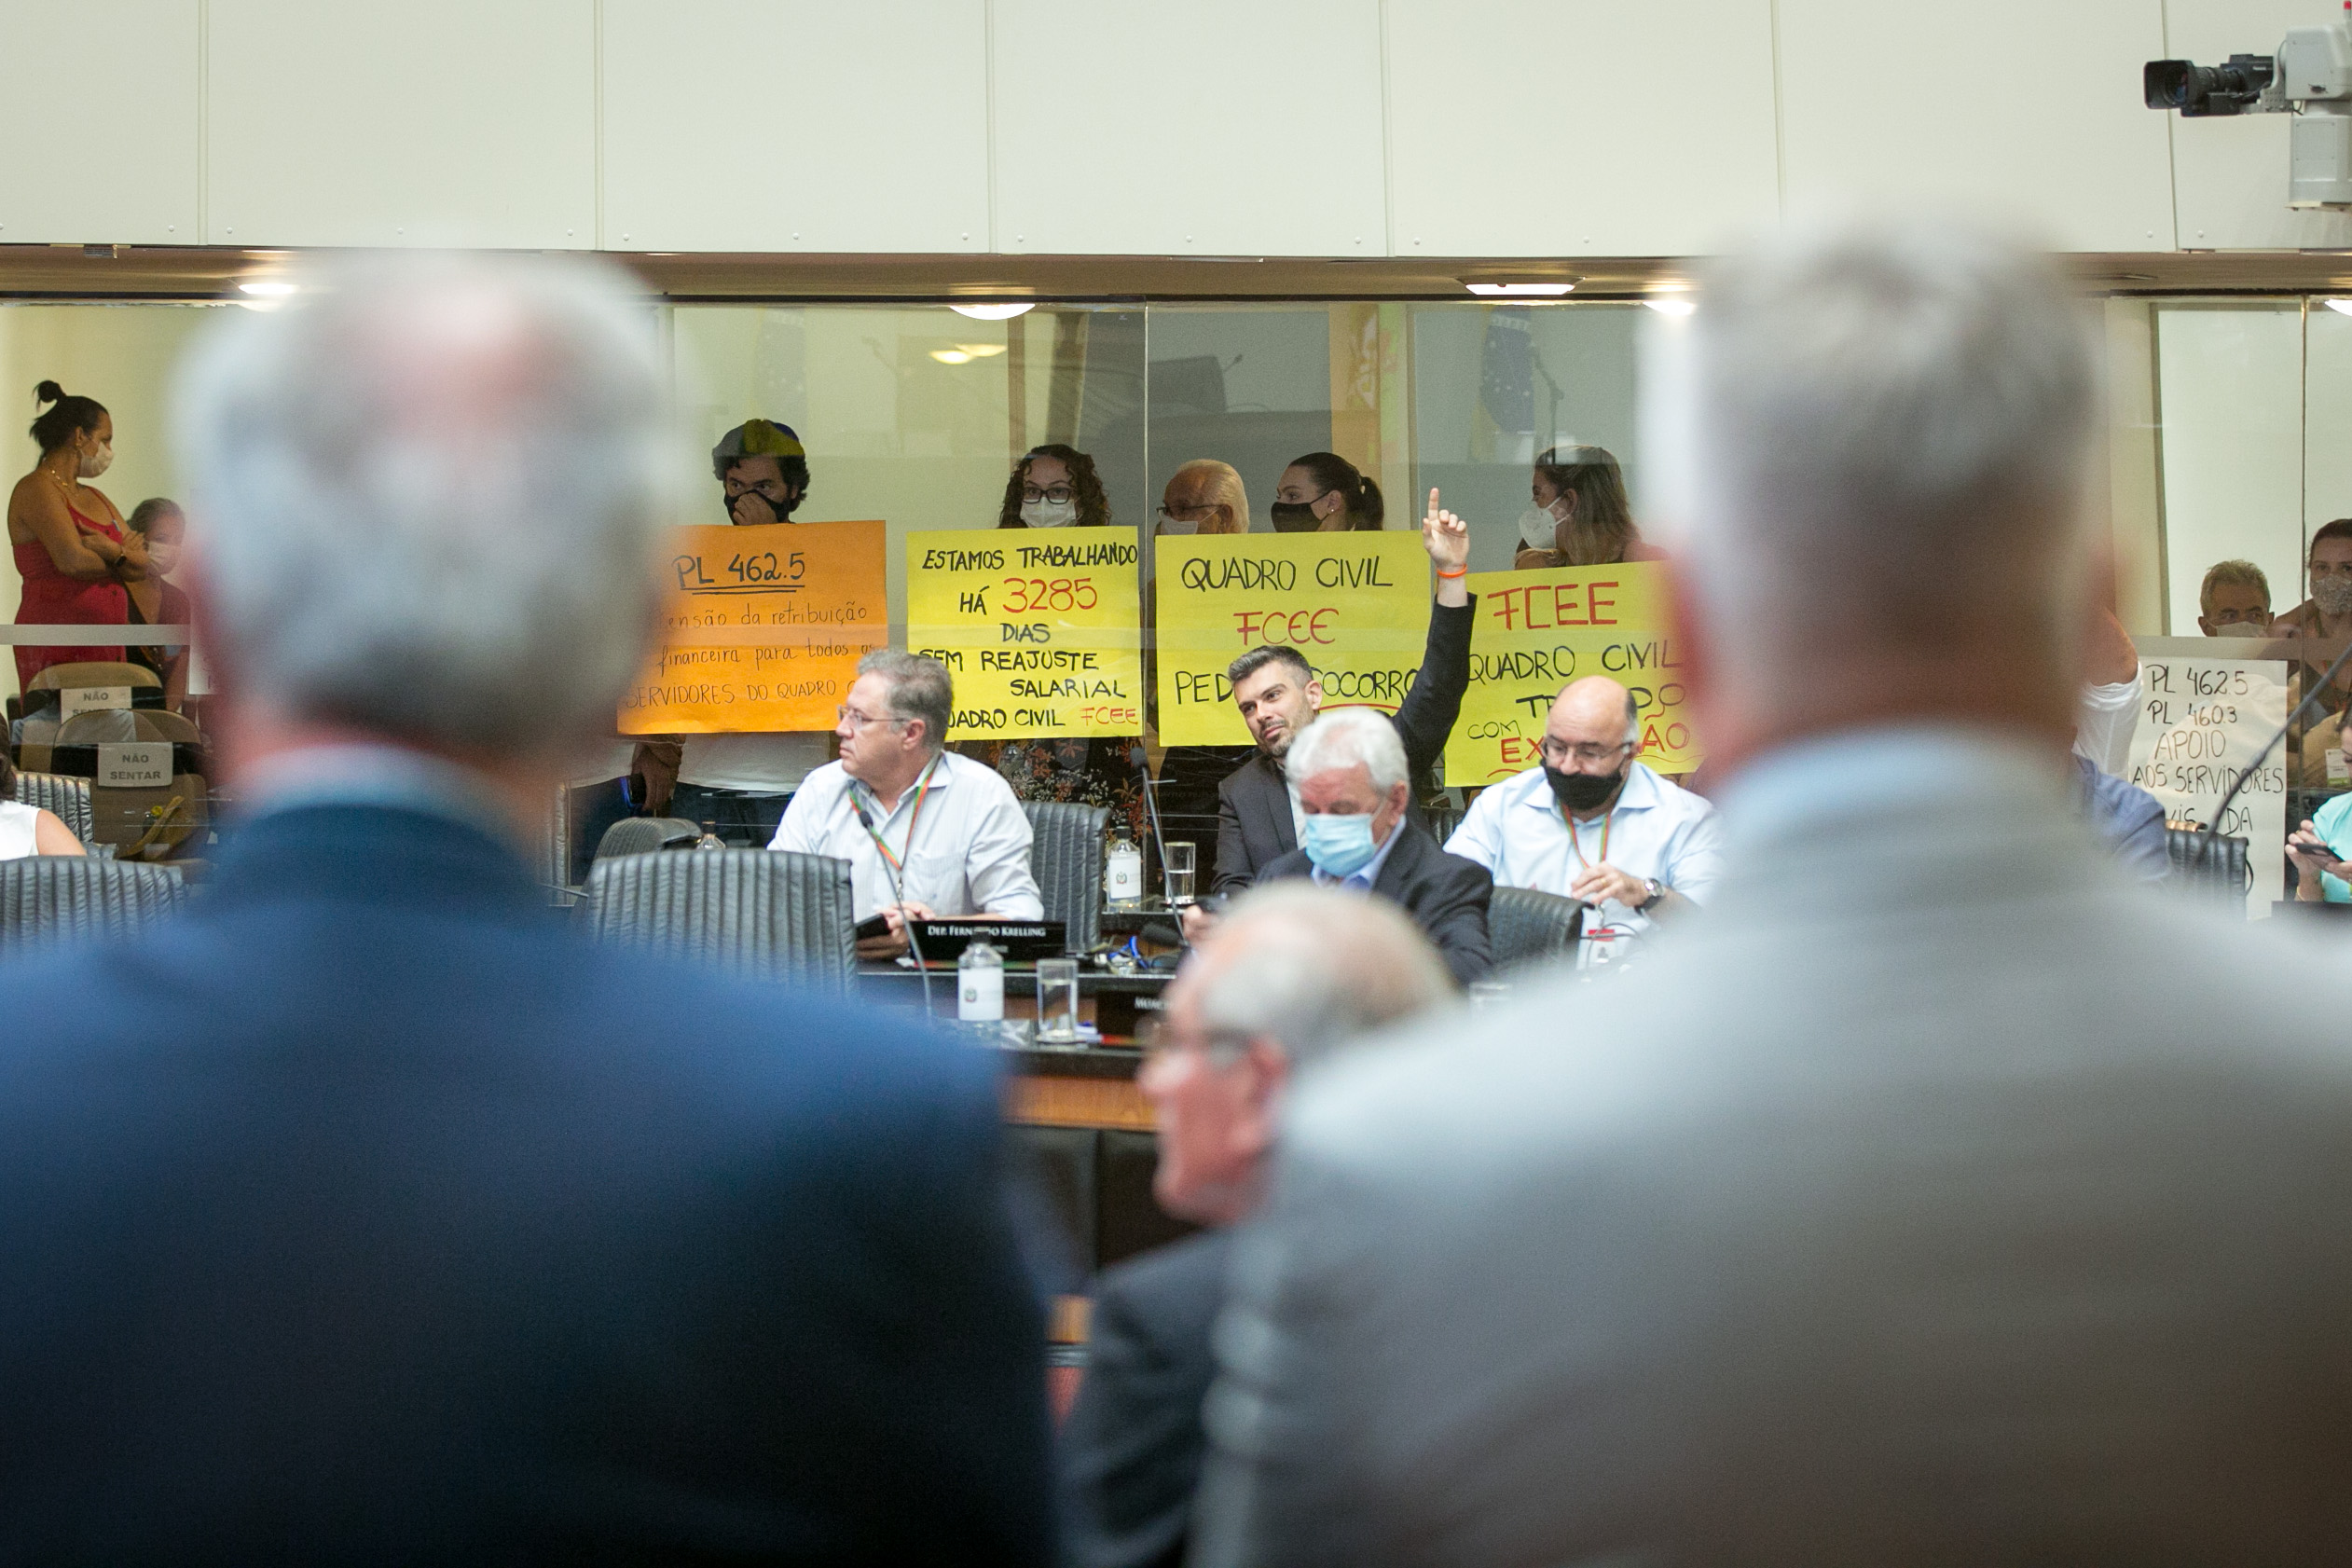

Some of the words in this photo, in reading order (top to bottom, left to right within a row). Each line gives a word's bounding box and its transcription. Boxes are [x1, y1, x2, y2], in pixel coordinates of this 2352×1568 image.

[671, 555, 714, 589] PL
[728, 552, 805, 582] 462.5
[922, 550, 1005, 571] ESTAMOS
[1016, 542, 1137, 569] TRABALHANDO
[1181, 557, 1296, 592] QUADRO
[1315, 556, 1394, 588] CIVIL
[959, 585, 990, 615] HÁ
[1002, 577, 1097, 613] 3285
[1487, 582, 1619, 631] FCEE
[667, 609, 727, 628] ensão
[741, 603, 761, 626] da
[772, 601, 867, 626] retribuição
[1233, 608, 1340, 646] FCEE
[999, 623, 1051, 643] DIAS
[656, 645, 741, 678] financeira
[755, 647, 798, 671] para
[807, 638, 849, 658] todos
[981, 651, 1099, 671] REAJUSTE
[1469, 645, 1575, 685] QUADRO
[1602, 640, 1684, 672] CIVIL
[1011, 680, 1127, 699] SALARIAL
[2146, 664, 2175, 695] PL
[83, 691, 109, 701] NÃO
[626, 683, 735, 708] SERVIDORES
[747, 684, 769, 701] DO
[777, 680, 837, 699] QUADRO
[948, 708, 1007, 730] UADRO
[1014, 708, 1066, 727] CIVIL
[1080, 707, 1138, 727] FCEE
[2147, 700, 2173, 724] PL
[1467, 720, 1521, 739] COM
[122, 753, 149, 763] NÃO
[2154, 730, 2226, 761] APOIO
[110, 771, 161, 780] SENTAR
[2132, 763, 2167, 788] AOS
[2175, 764, 2284, 794] SERVIDORES
[950, 925, 1000, 937] FERNO
